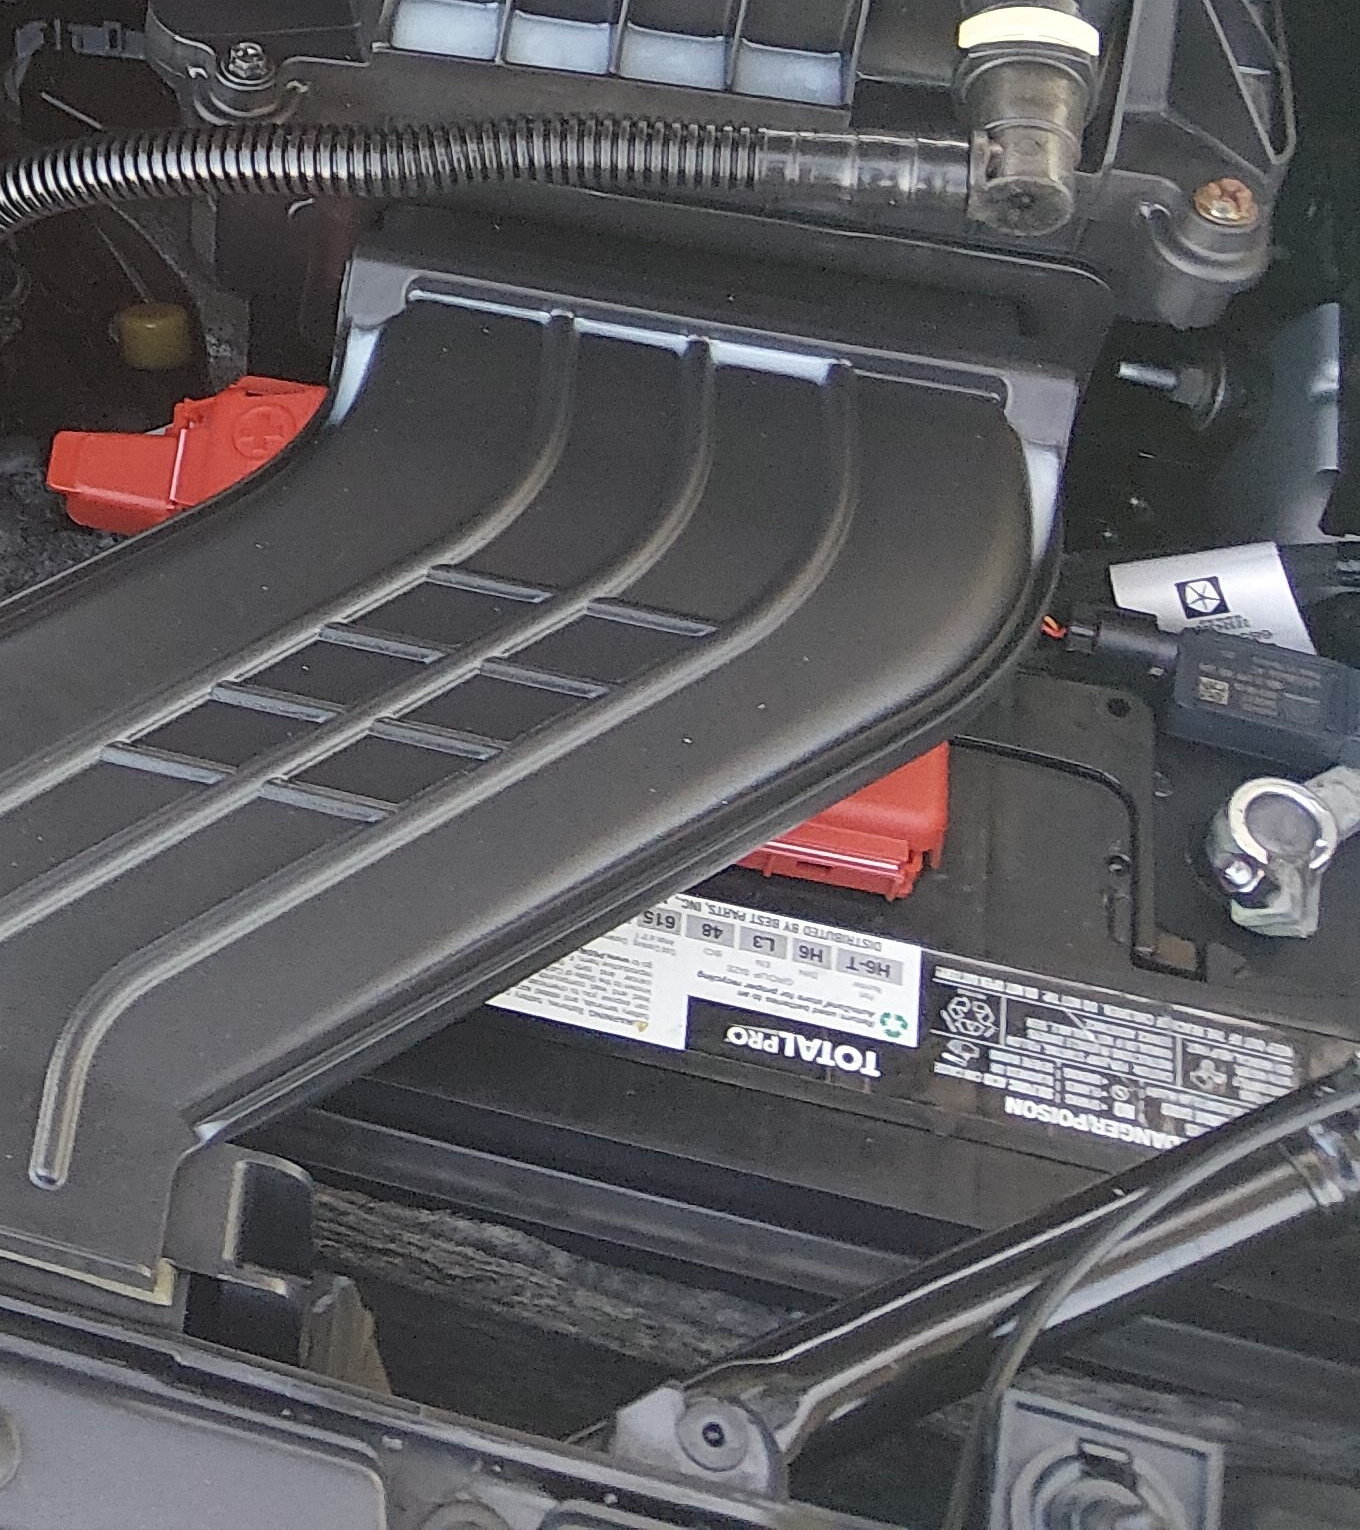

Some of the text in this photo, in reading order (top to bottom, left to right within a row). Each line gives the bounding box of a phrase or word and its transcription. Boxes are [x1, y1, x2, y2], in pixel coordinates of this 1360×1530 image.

[643, 911, 676, 929] 615
[705, 902, 746, 923] PARTS,
[750, 913, 779, 929] BEST
[702, 923, 723, 939] 48
[783, 921, 799, 937] BY
[803, 925, 881, 951] DISTRIBUTED
[753, 936, 775, 952] L3
[799, 945, 823, 963] H6
[845, 957, 890, 978] H6-T
